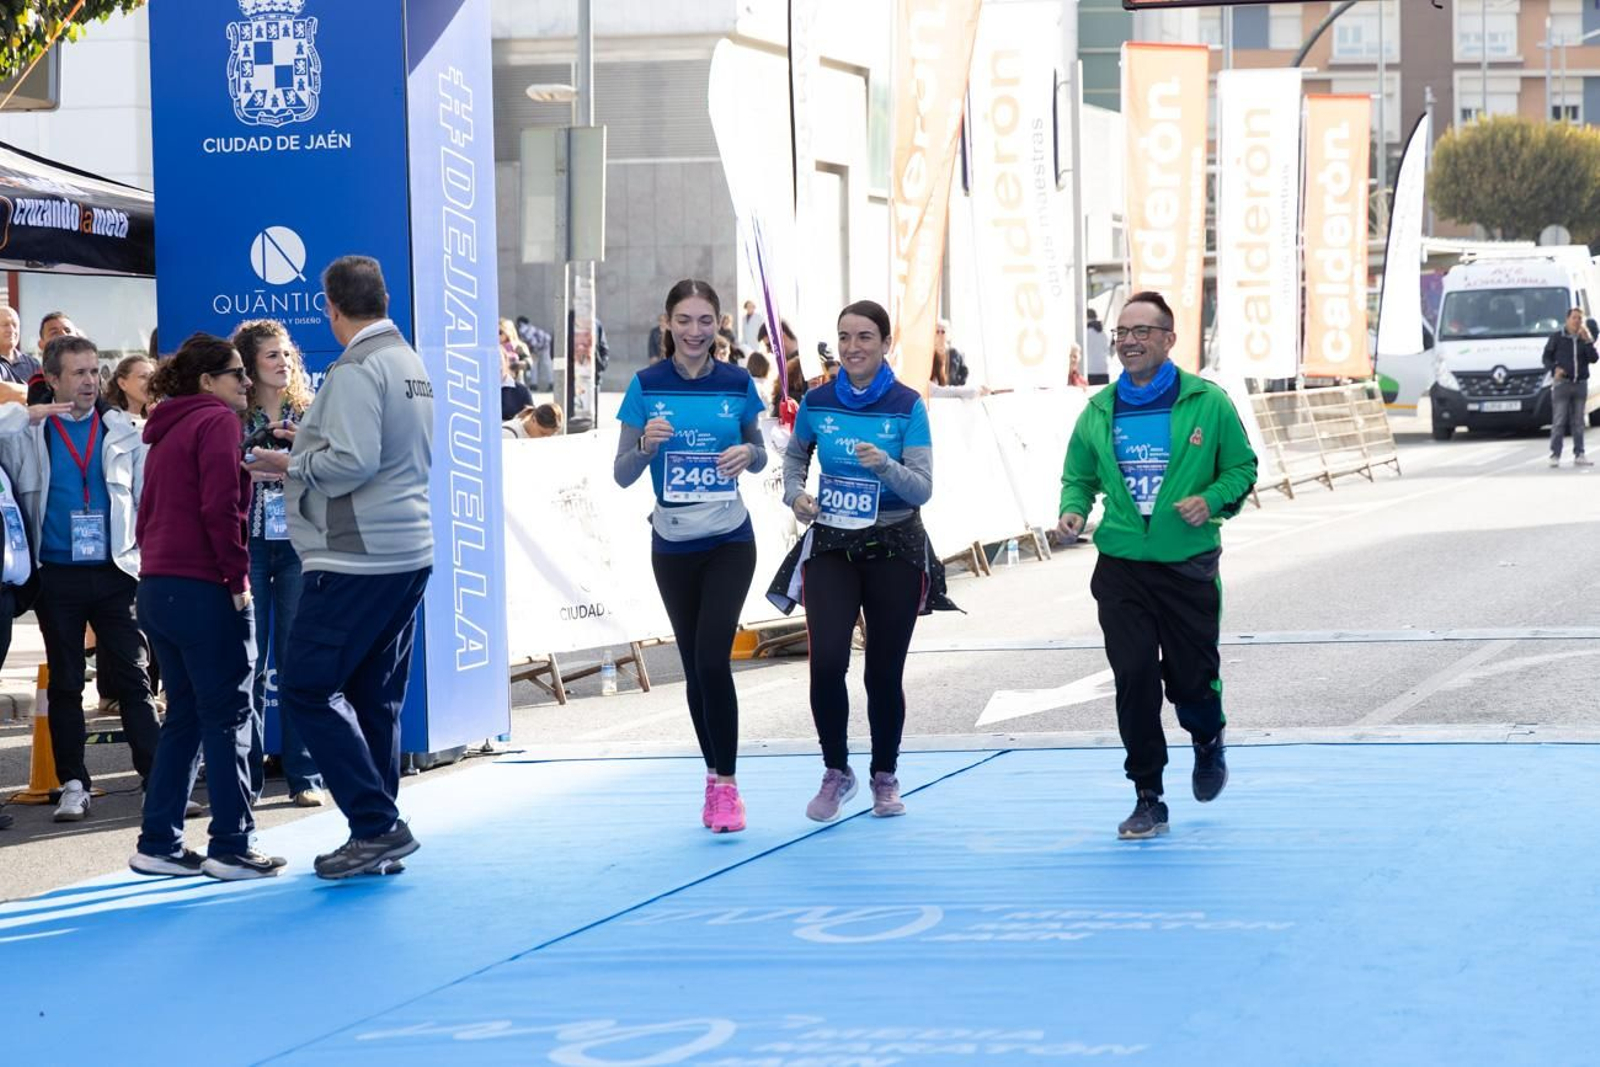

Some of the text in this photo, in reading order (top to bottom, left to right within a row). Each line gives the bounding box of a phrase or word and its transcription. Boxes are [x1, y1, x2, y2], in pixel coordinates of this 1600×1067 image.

[203, 130, 351, 153] CIUDAD DE JAÉN
[1134, 76, 1182, 300] lderón
[1235, 108, 1271, 361] calderón
[1314, 119, 1353, 364] calderón
[438, 65, 490, 672] #DEJAHUELLA
[559, 603, 605, 621] CIUDAD
[821, 488, 872, 512] 2008
